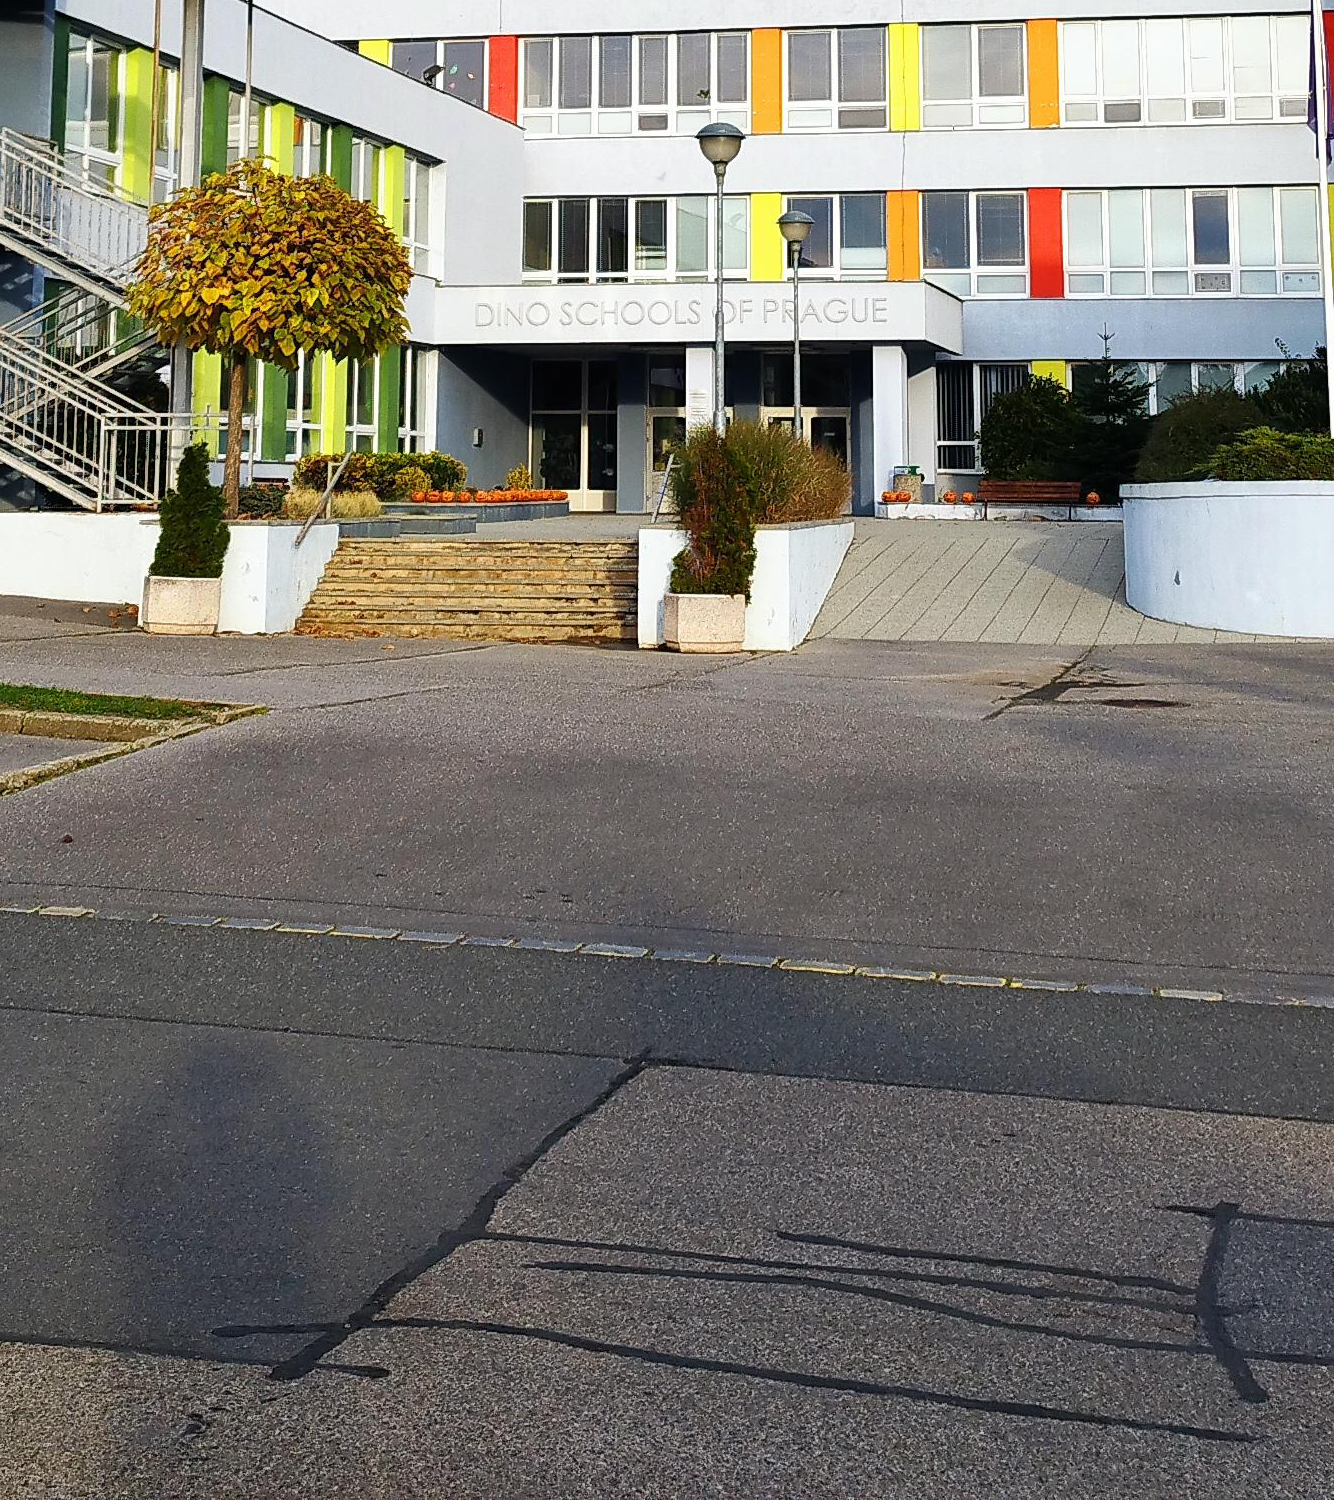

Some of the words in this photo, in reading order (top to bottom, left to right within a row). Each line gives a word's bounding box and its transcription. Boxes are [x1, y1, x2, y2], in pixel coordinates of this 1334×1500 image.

[474, 301, 551, 328] DINO
[559, 298, 702, 327] SCHOOLS
[712, 298, 754, 325] OF
[763, 296, 889, 324] PRAGUE
